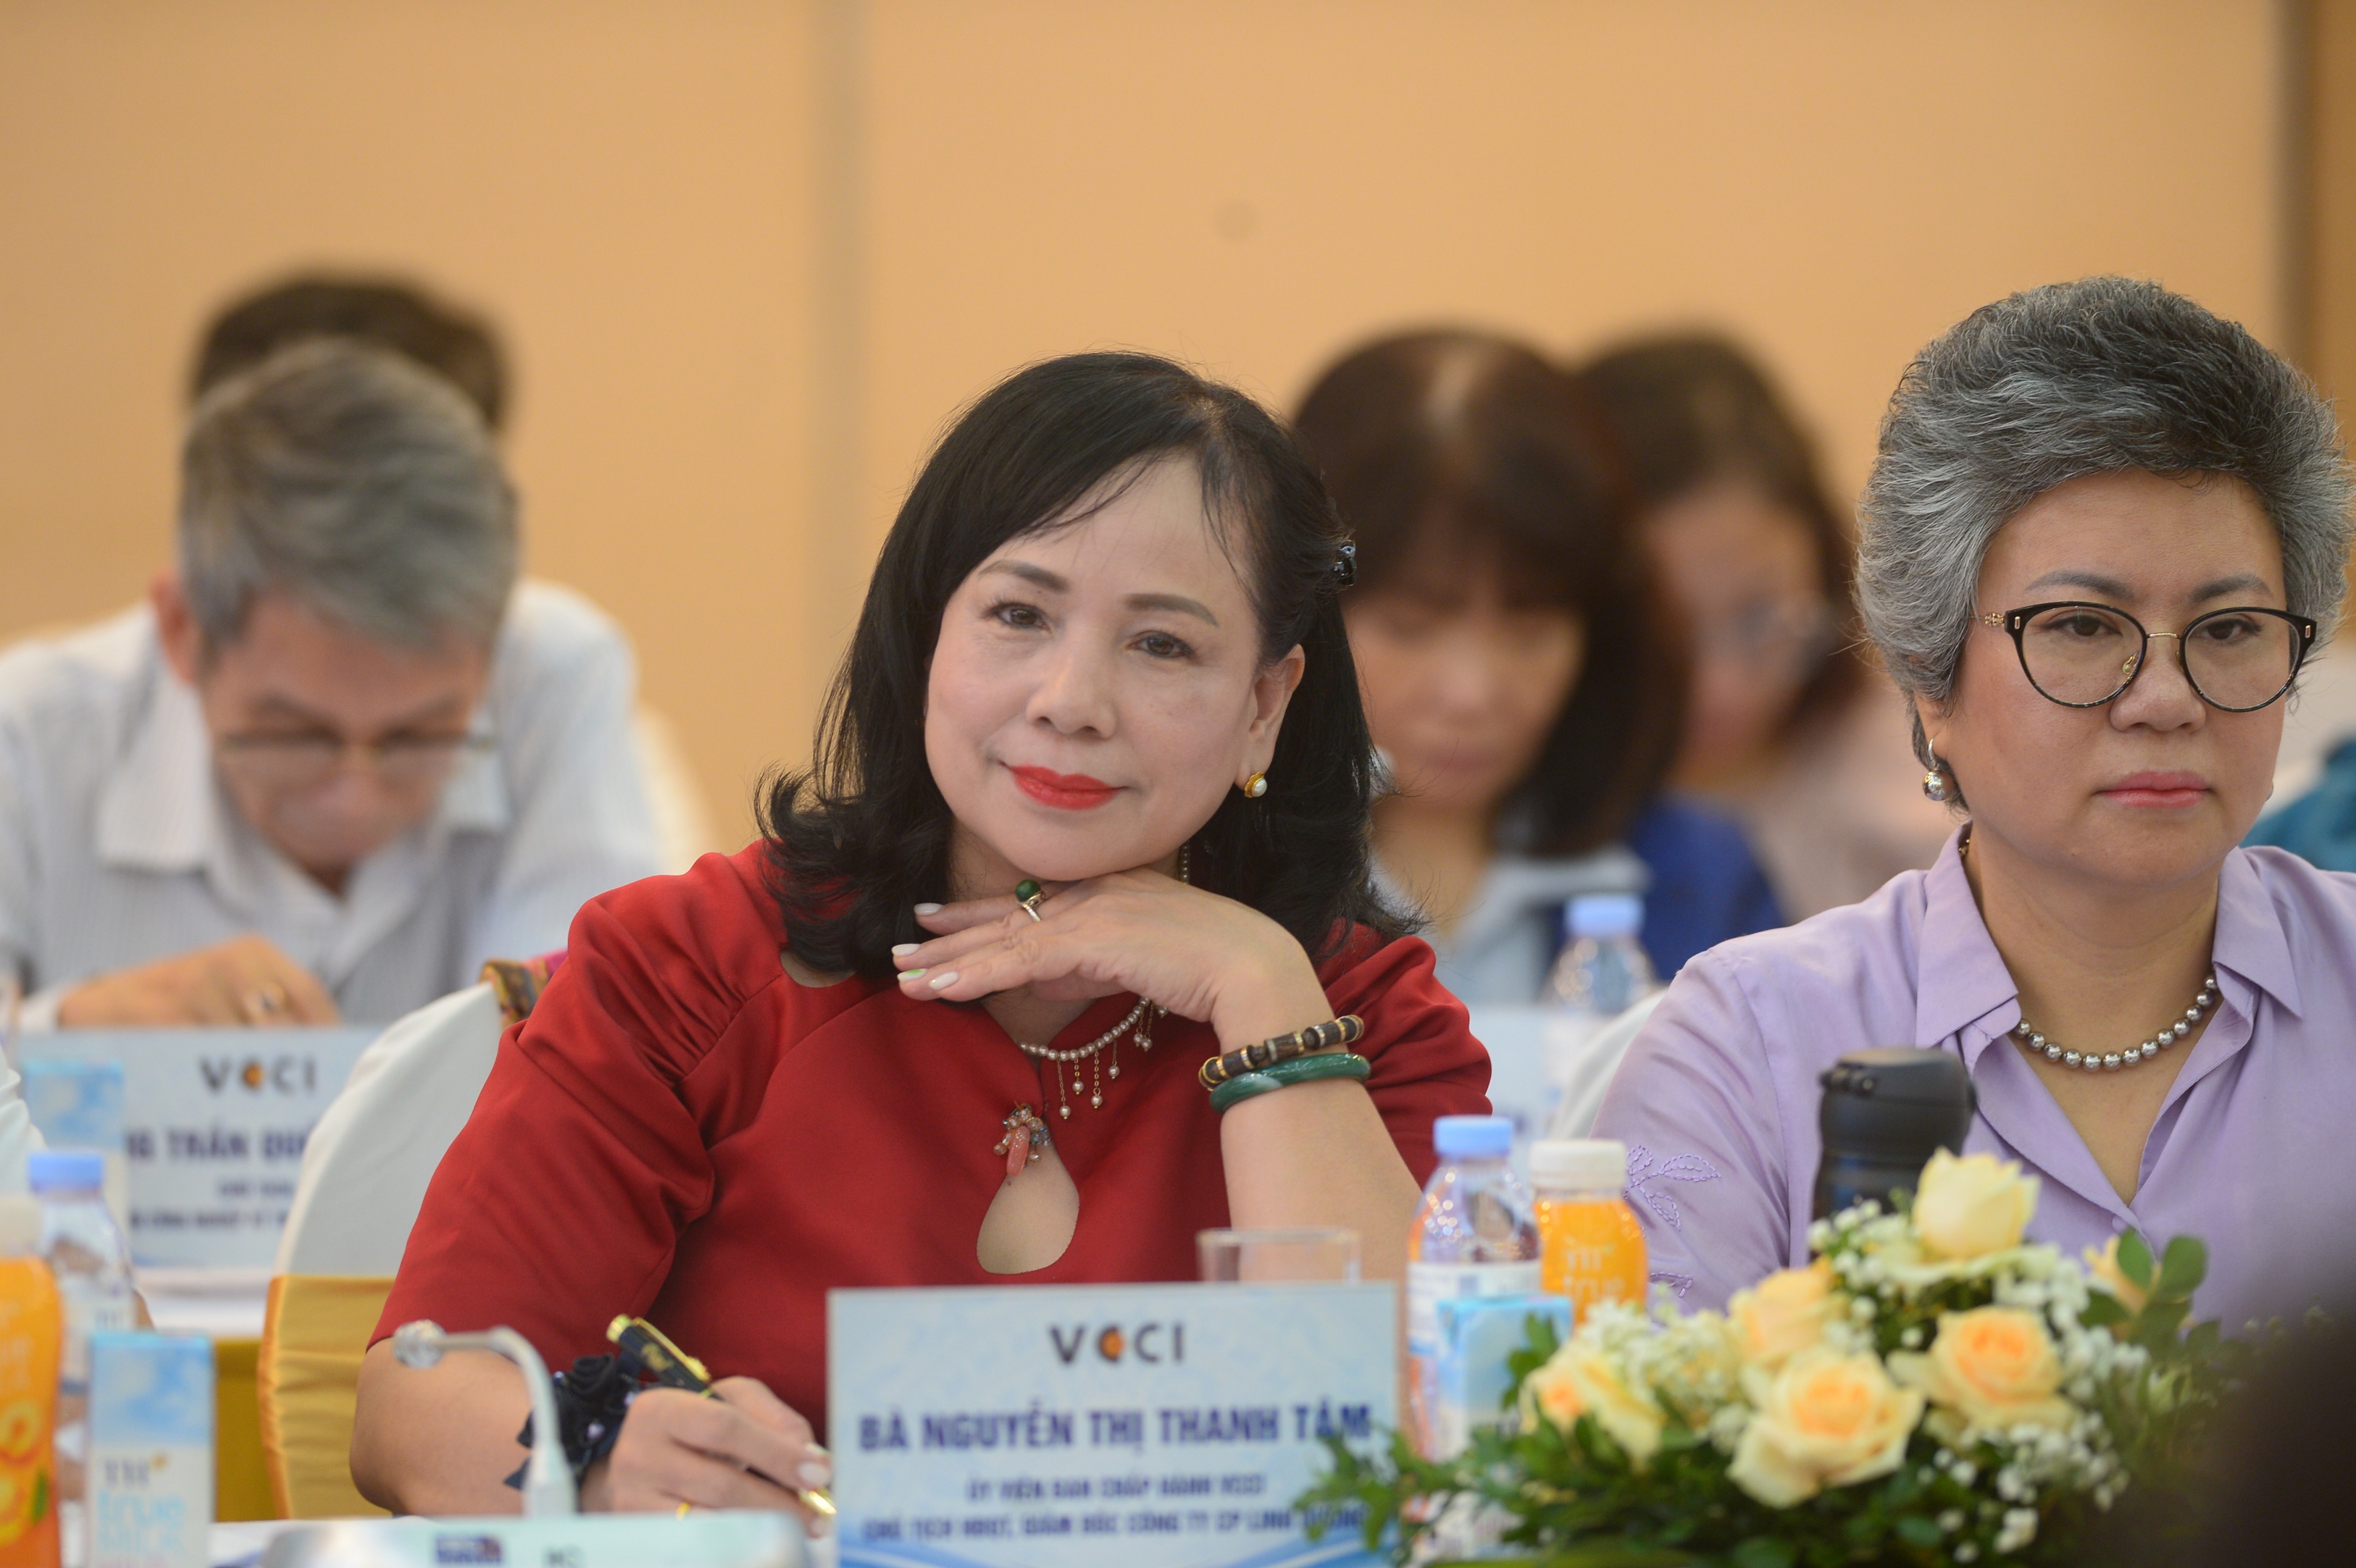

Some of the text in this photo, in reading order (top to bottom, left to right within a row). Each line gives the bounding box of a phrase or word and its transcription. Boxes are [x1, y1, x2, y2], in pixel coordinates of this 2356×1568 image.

[199, 1055, 317, 1092] VCCI
[1050, 1324, 1185, 1364] VCCI
[860, 1396, 1371, 1454] BÀ NGUYỄN THỊ THANH TÂM
